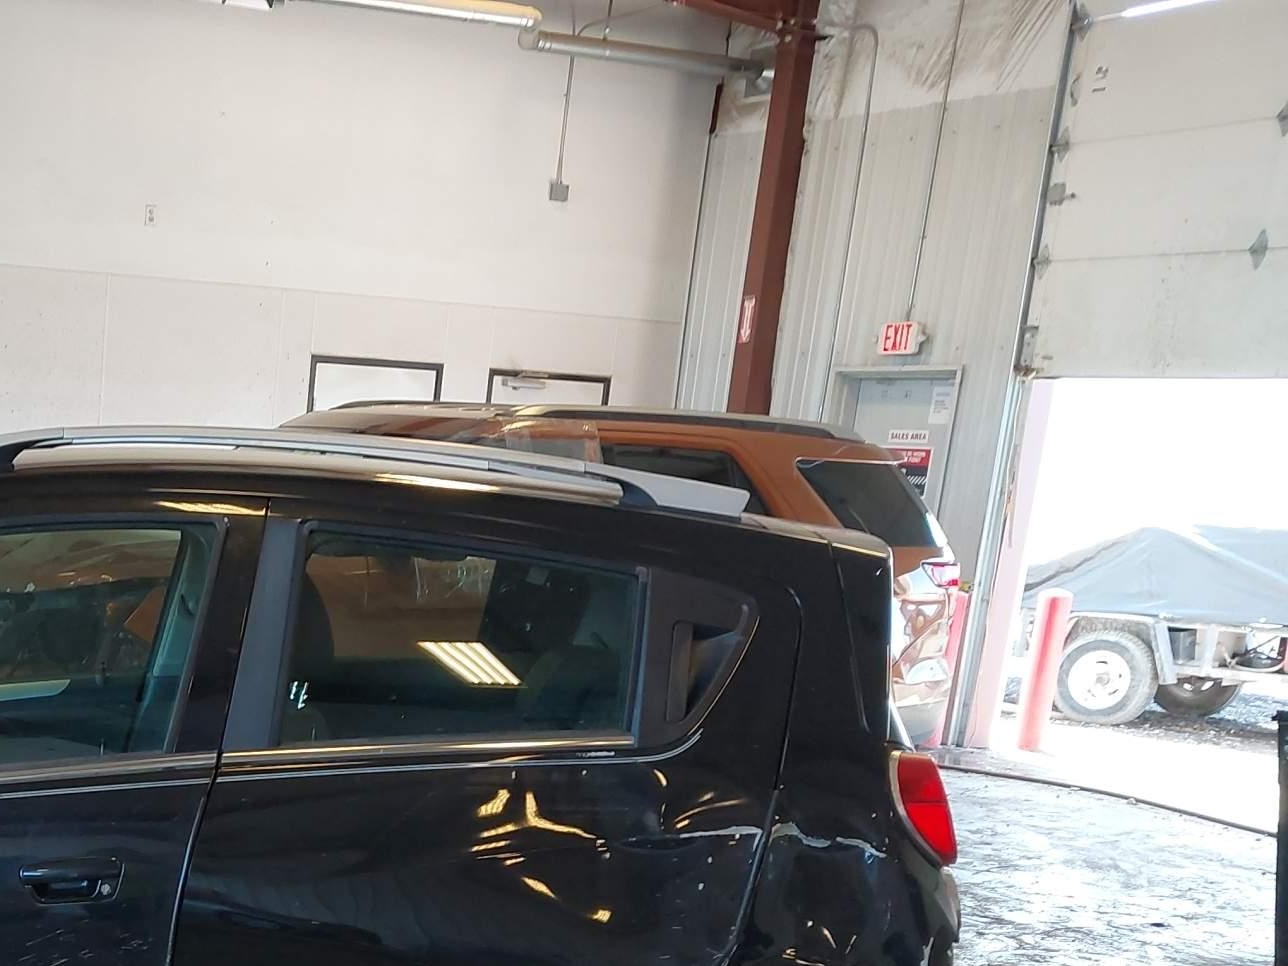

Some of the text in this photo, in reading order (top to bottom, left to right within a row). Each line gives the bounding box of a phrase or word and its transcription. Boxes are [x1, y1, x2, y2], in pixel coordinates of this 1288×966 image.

[883, 323, 913, 352] EXIT
[890, 432, 927, 441] SALES AREA
